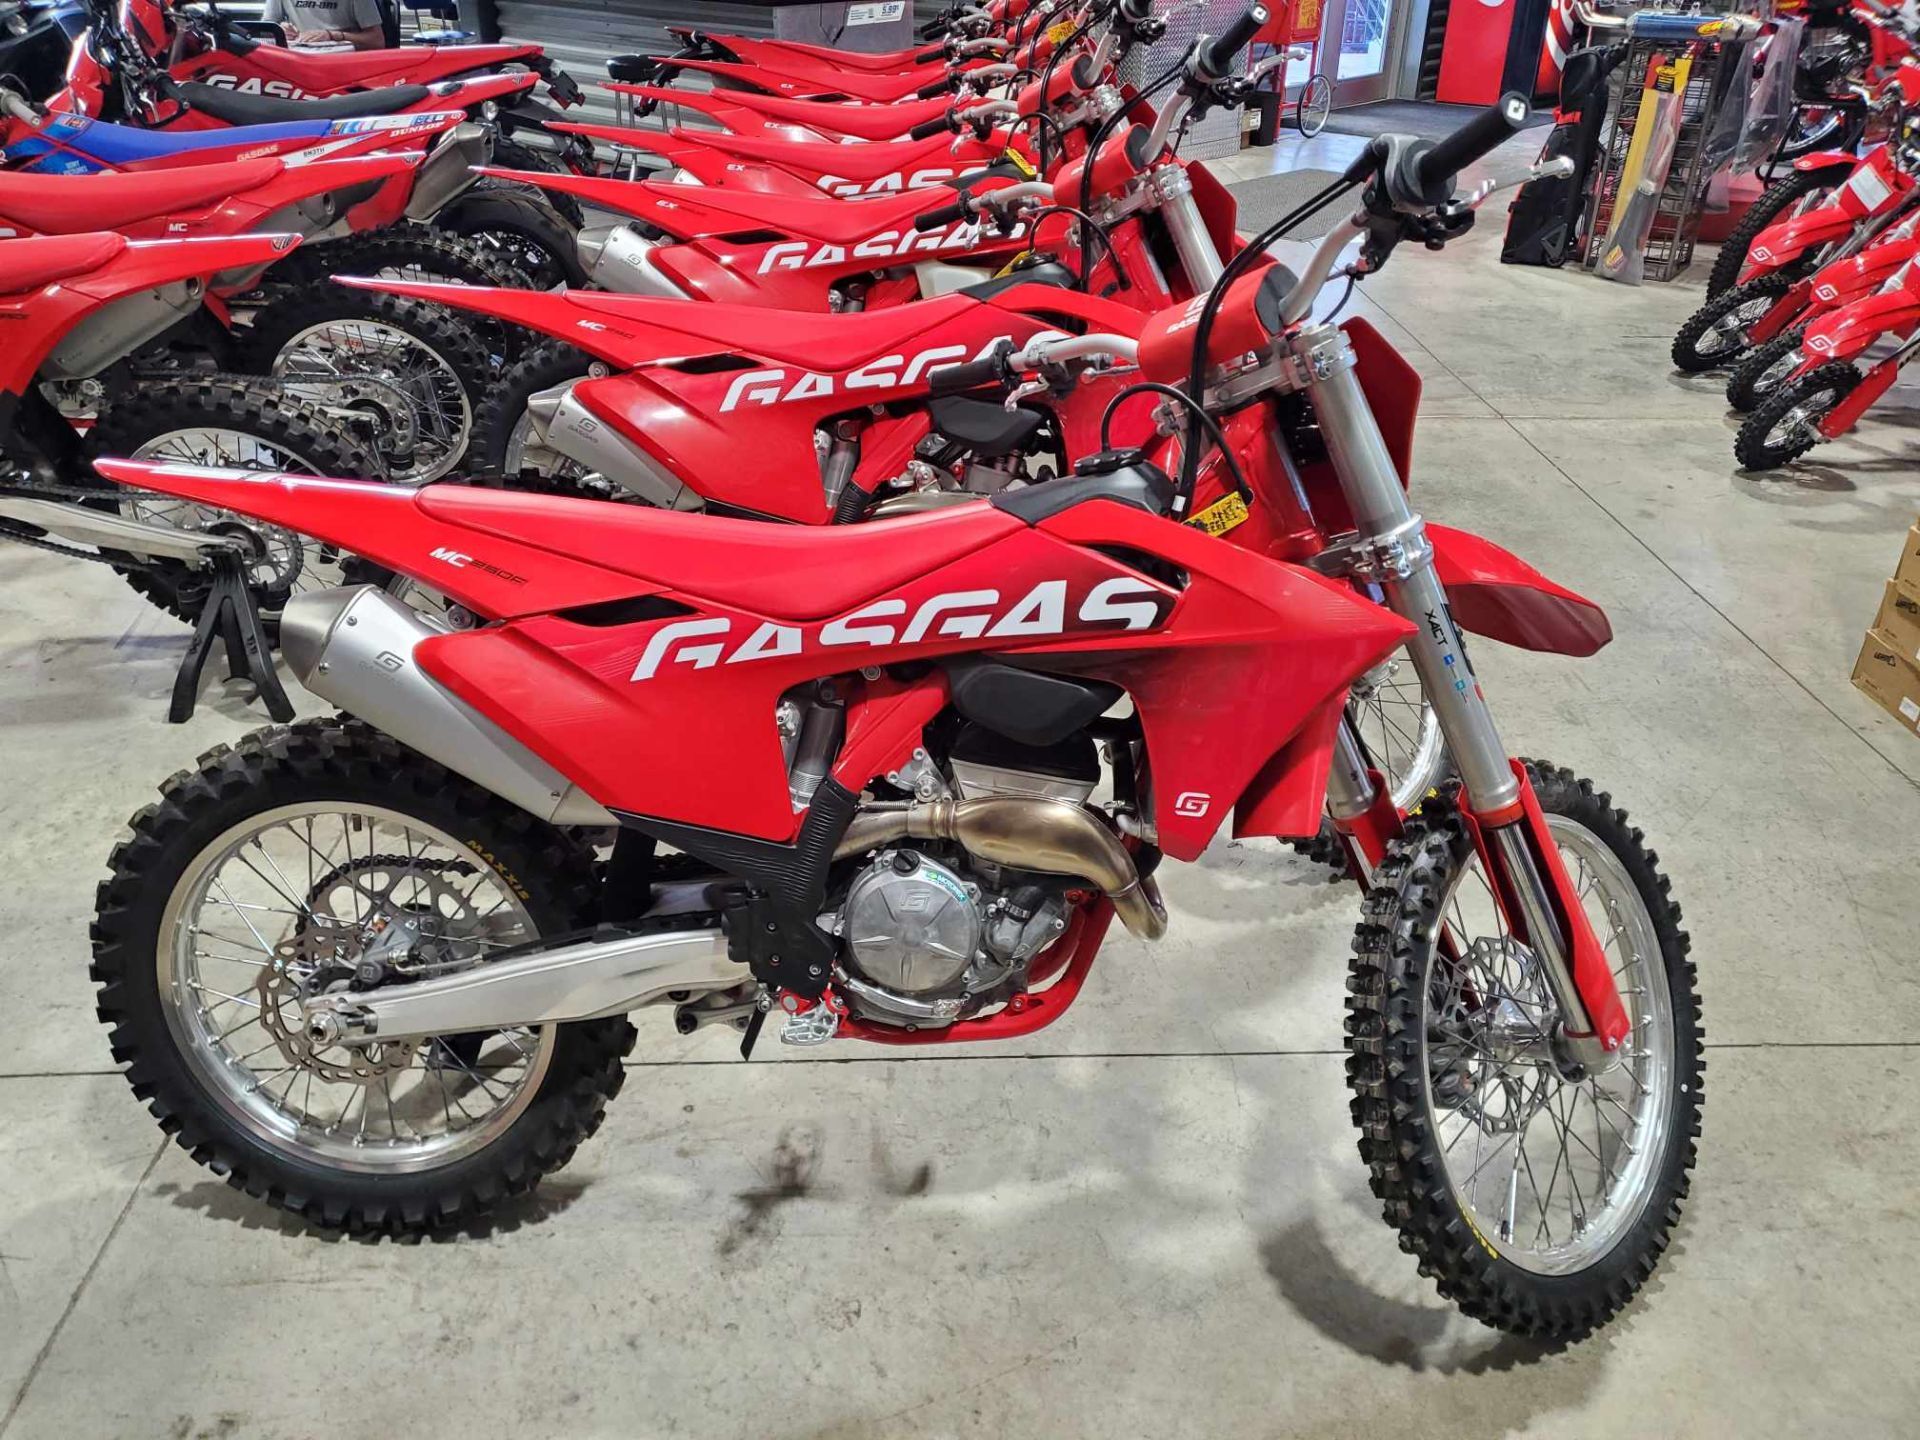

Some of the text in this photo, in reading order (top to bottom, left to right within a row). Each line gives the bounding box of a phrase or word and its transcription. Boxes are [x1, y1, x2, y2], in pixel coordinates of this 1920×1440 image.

[296, 1, 338, 9] can-am
[390, 121, 446, 138] DUNLOP
[237, 144, 278, 162] GASGAS
[169, 223, 188, 232] MC
[630, 577, 1158, 682] GASGAS
[1424, 609, 1448, 645] XACT
